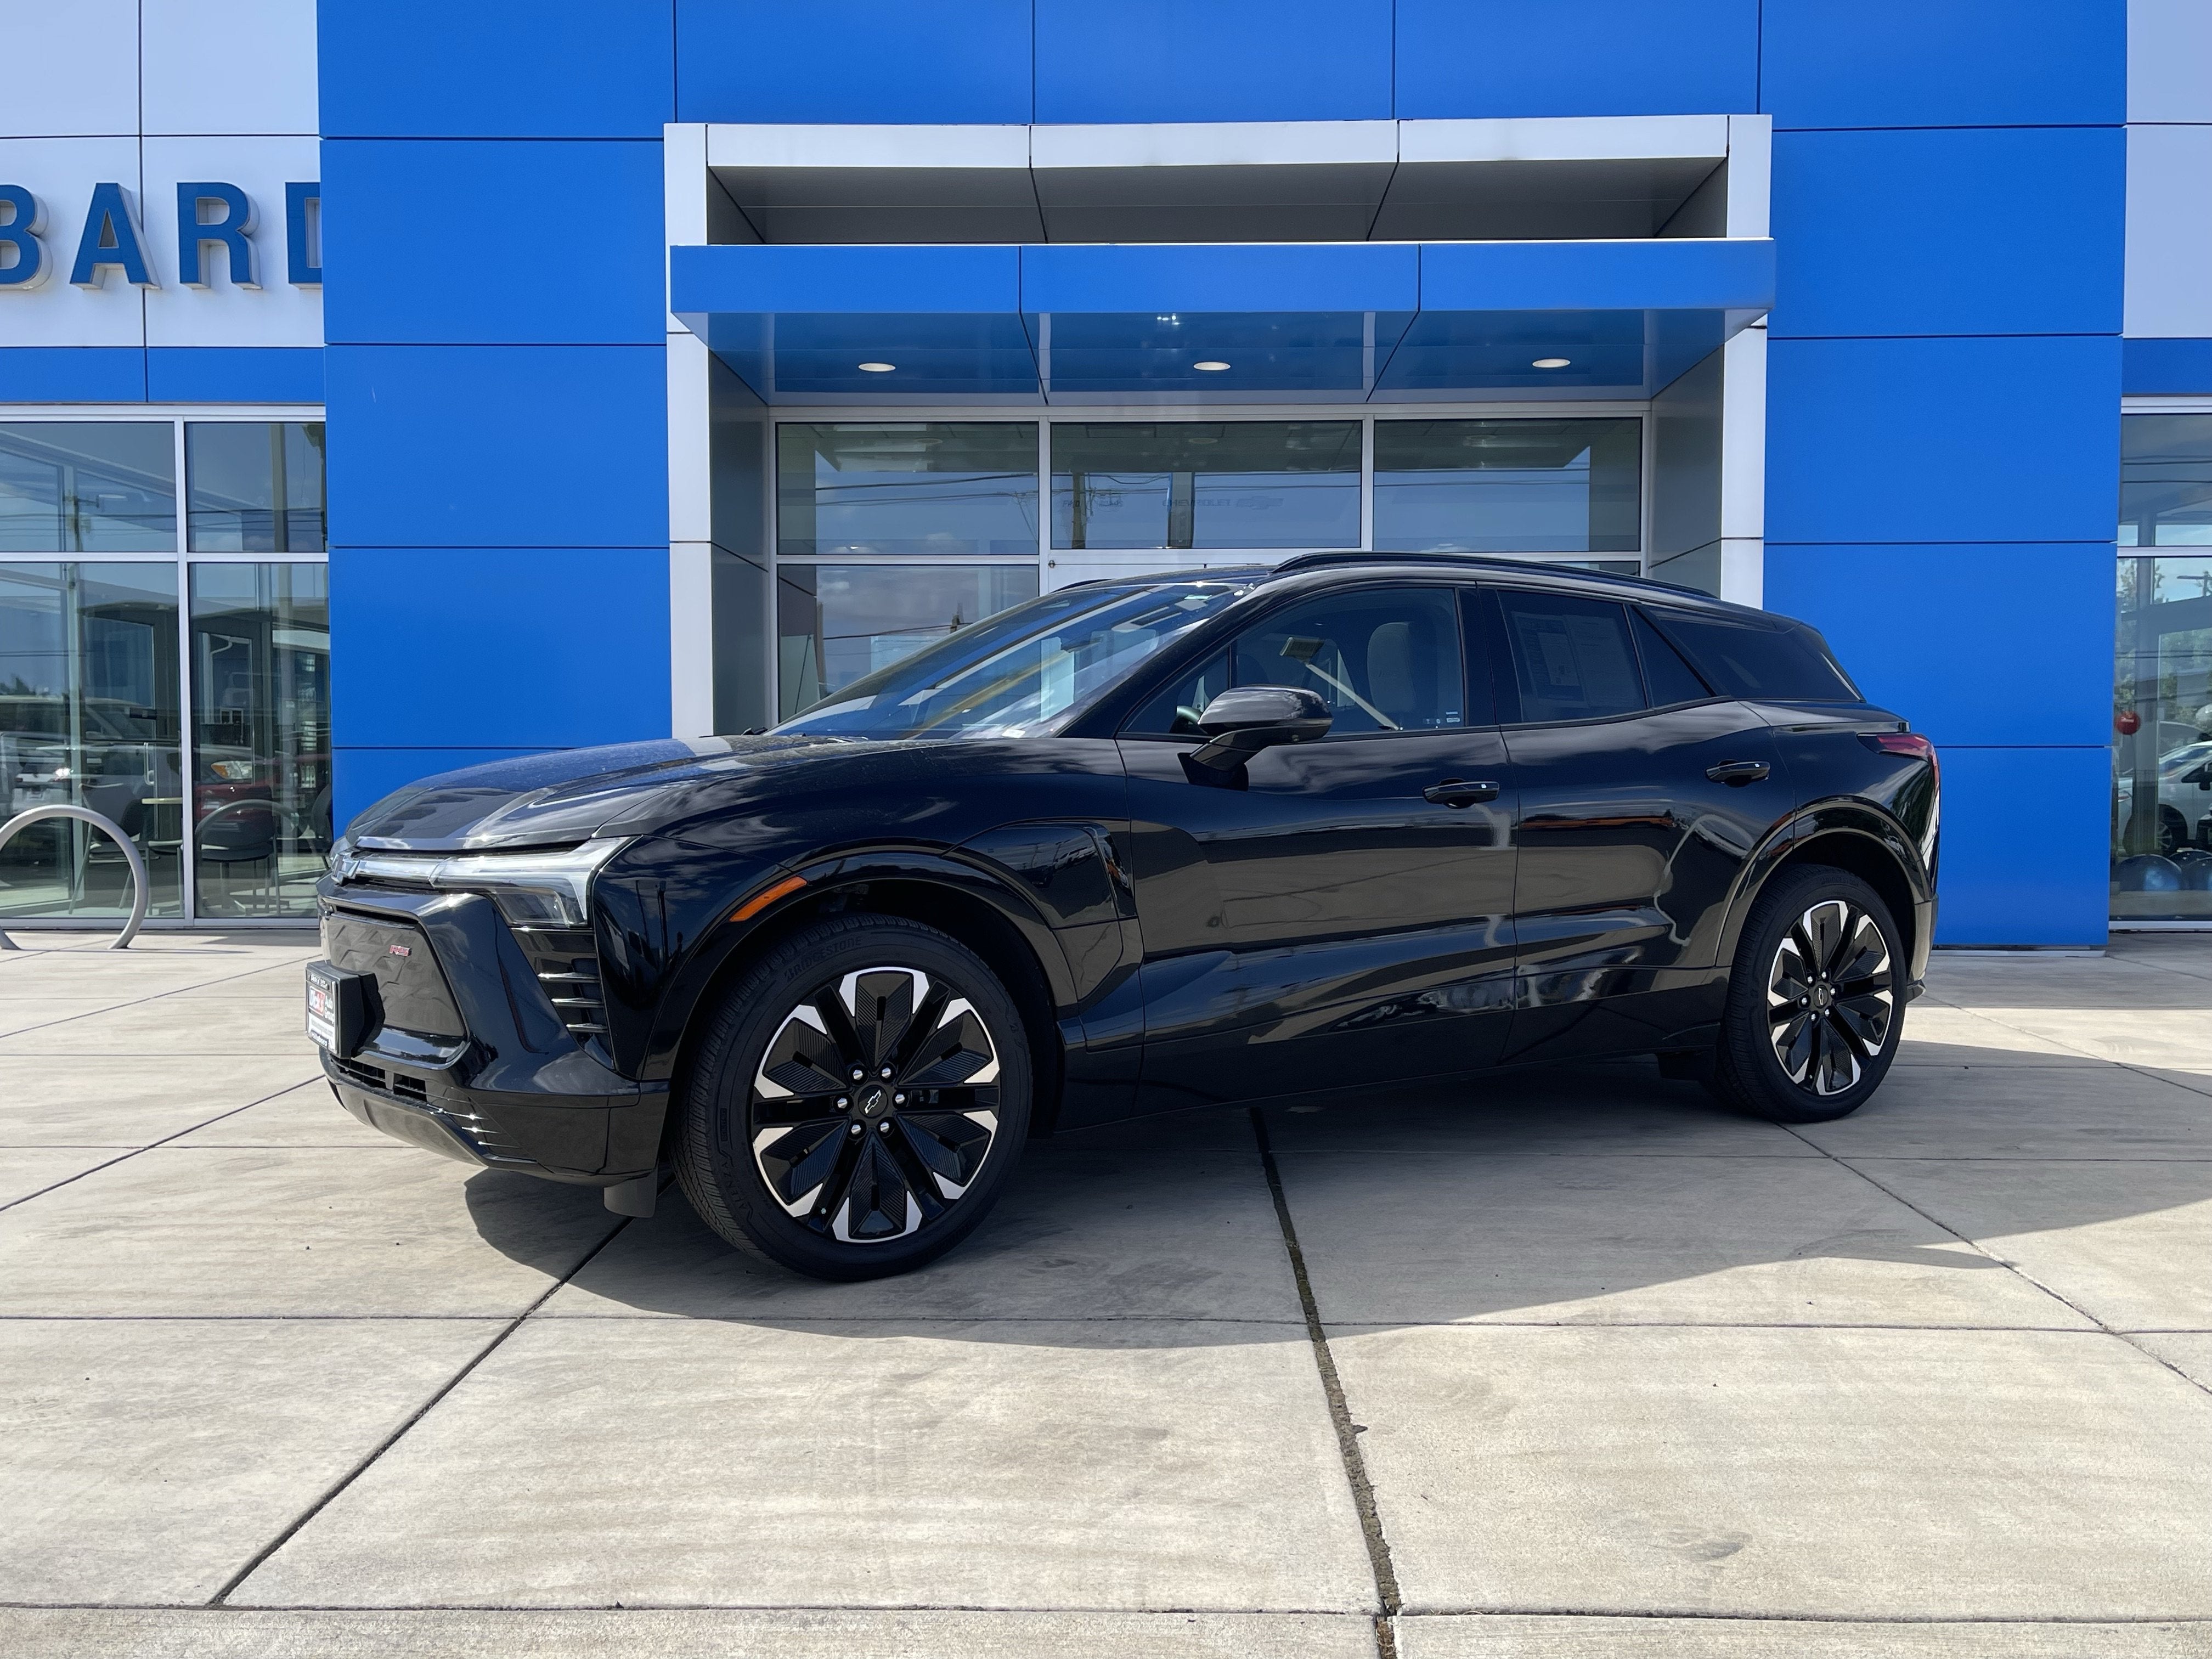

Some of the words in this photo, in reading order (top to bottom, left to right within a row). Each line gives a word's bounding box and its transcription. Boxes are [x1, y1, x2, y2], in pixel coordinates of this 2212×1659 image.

[389, 945, 410, 956] RS
[784, 936, 861, 982] BRIDGESTONE
[309, 989, 324, 1013] Dick's
